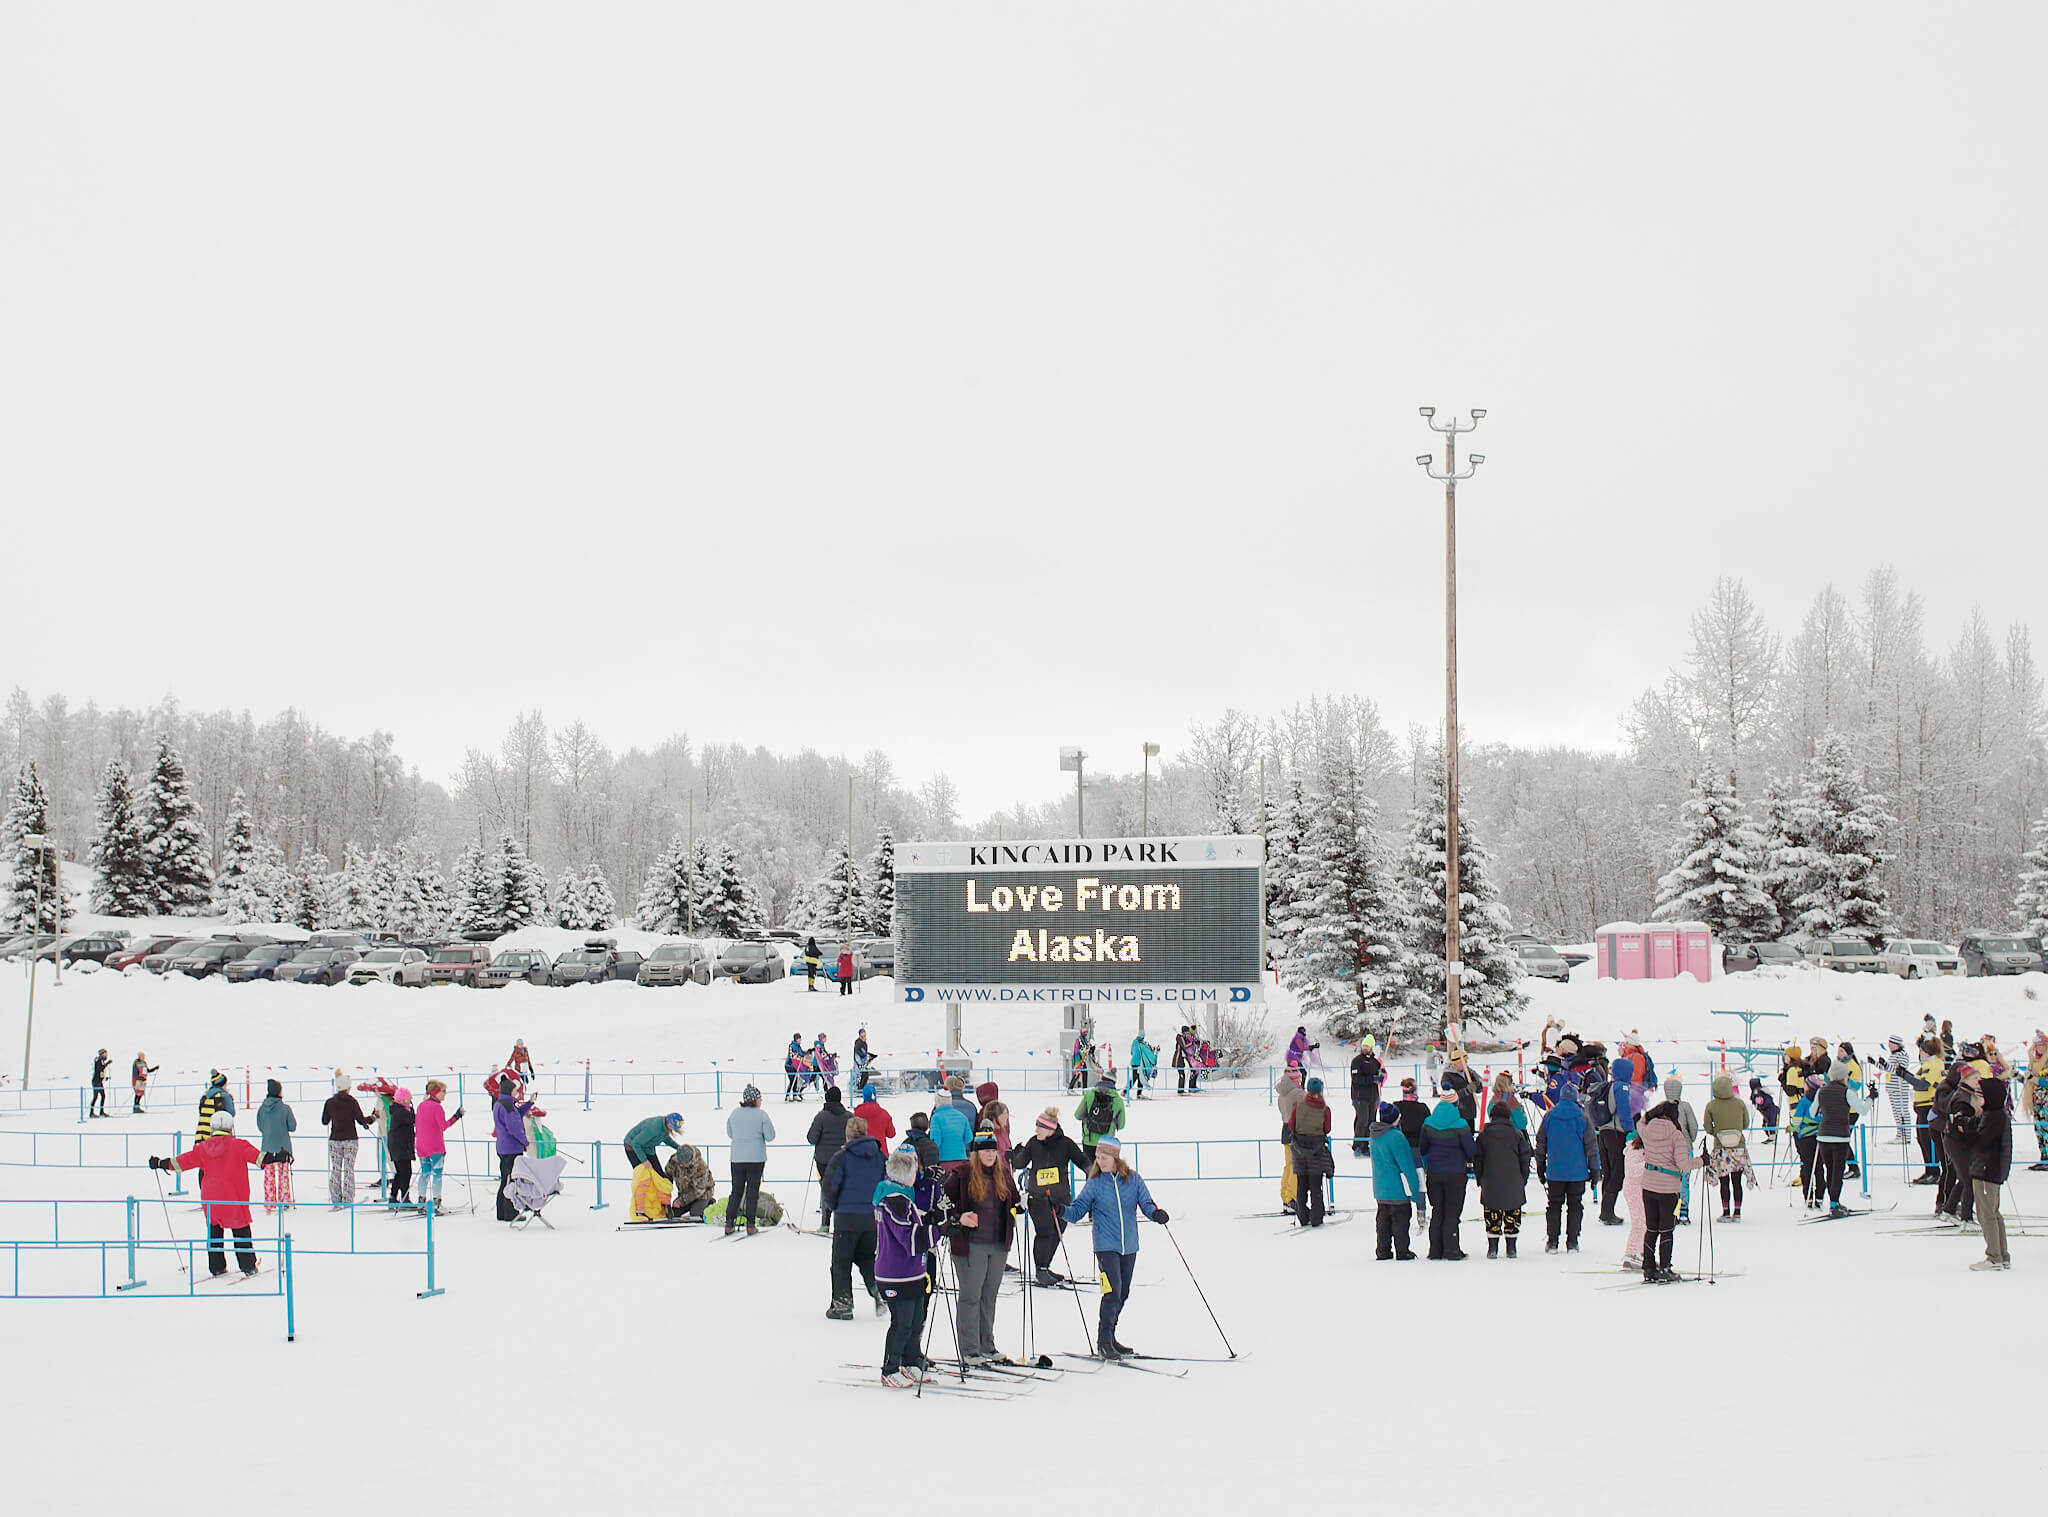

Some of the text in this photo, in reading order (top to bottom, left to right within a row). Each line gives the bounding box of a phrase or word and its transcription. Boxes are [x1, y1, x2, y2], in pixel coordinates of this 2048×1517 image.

[970, 843, 1179, 865] KINCAID PARK
[966, 877, 1181, 913] Love From
[1007, 928, 1142, 963] Alaska
[937, 986, 1218, 1003] WWW.DAKTRONICS.COM
